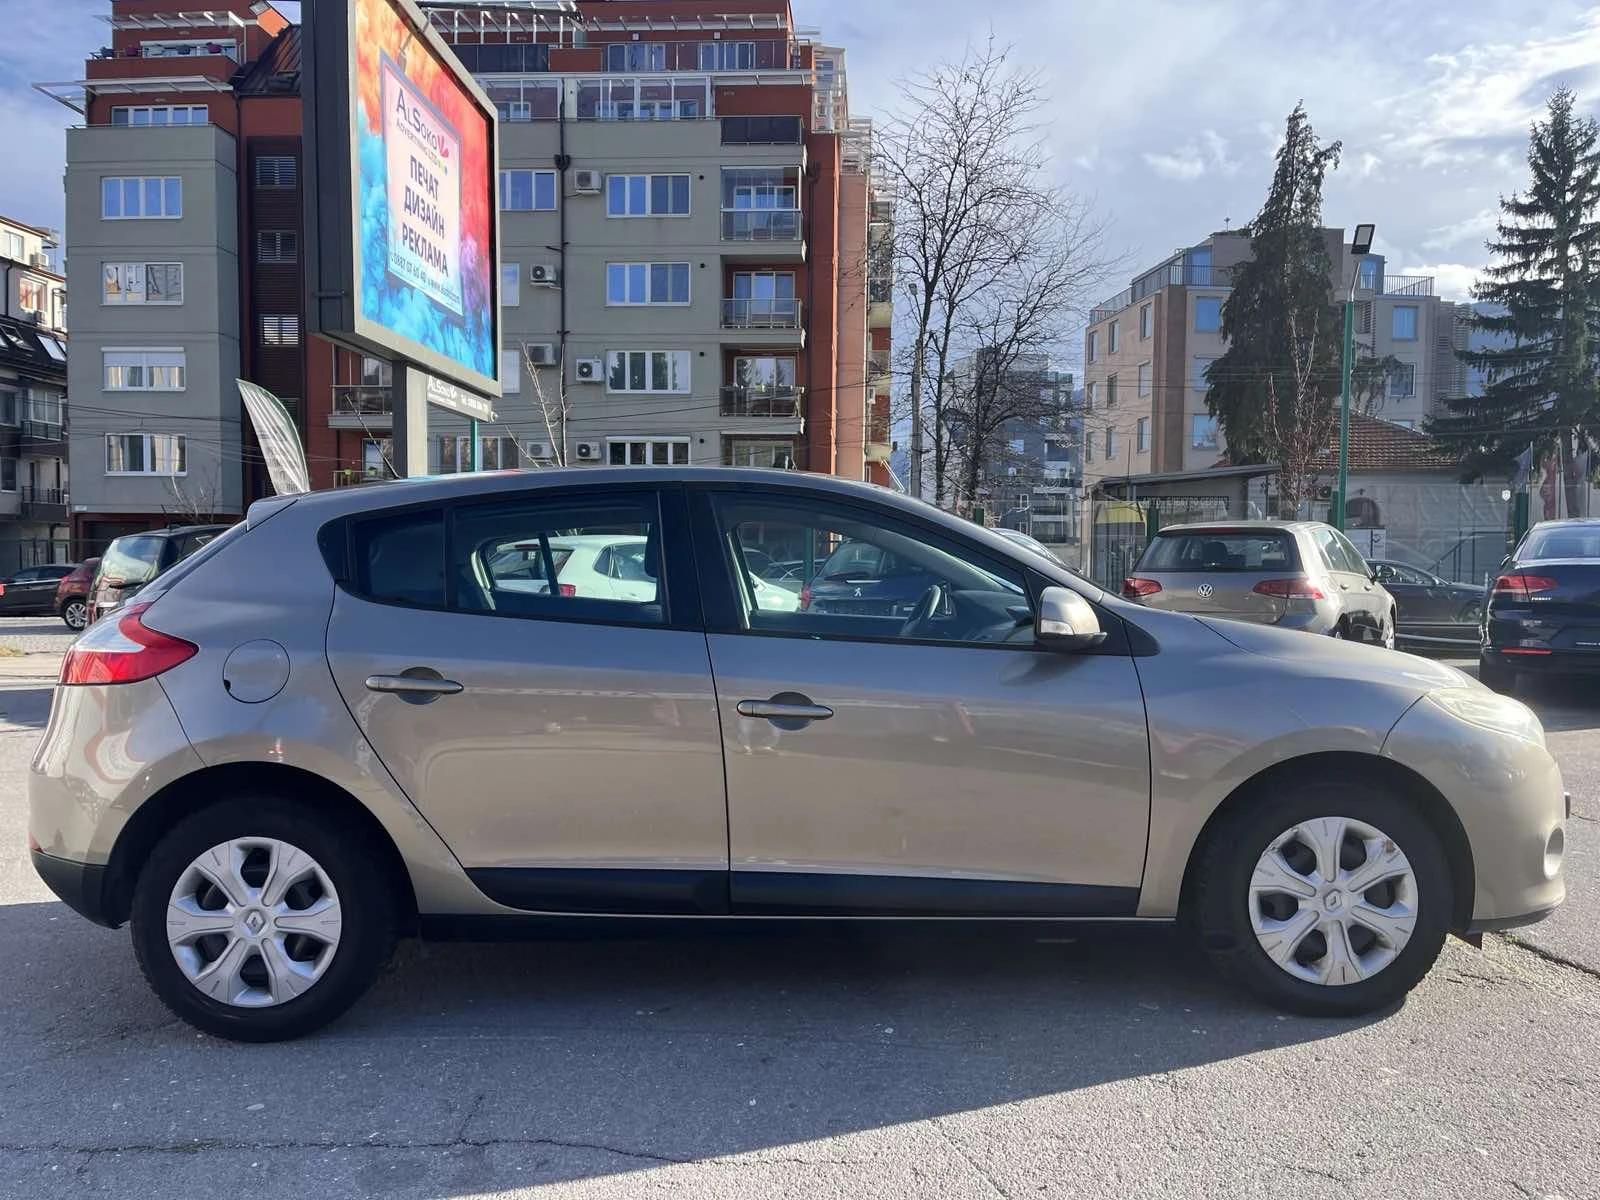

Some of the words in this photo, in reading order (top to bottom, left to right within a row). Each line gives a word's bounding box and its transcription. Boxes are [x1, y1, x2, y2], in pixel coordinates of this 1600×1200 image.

[410, 154, 439, 201] ПЕЧАТ
[404, 184, 445, 240] ДИЗАЙН
[402, 222, 449, 277] РЕКЛАМА
